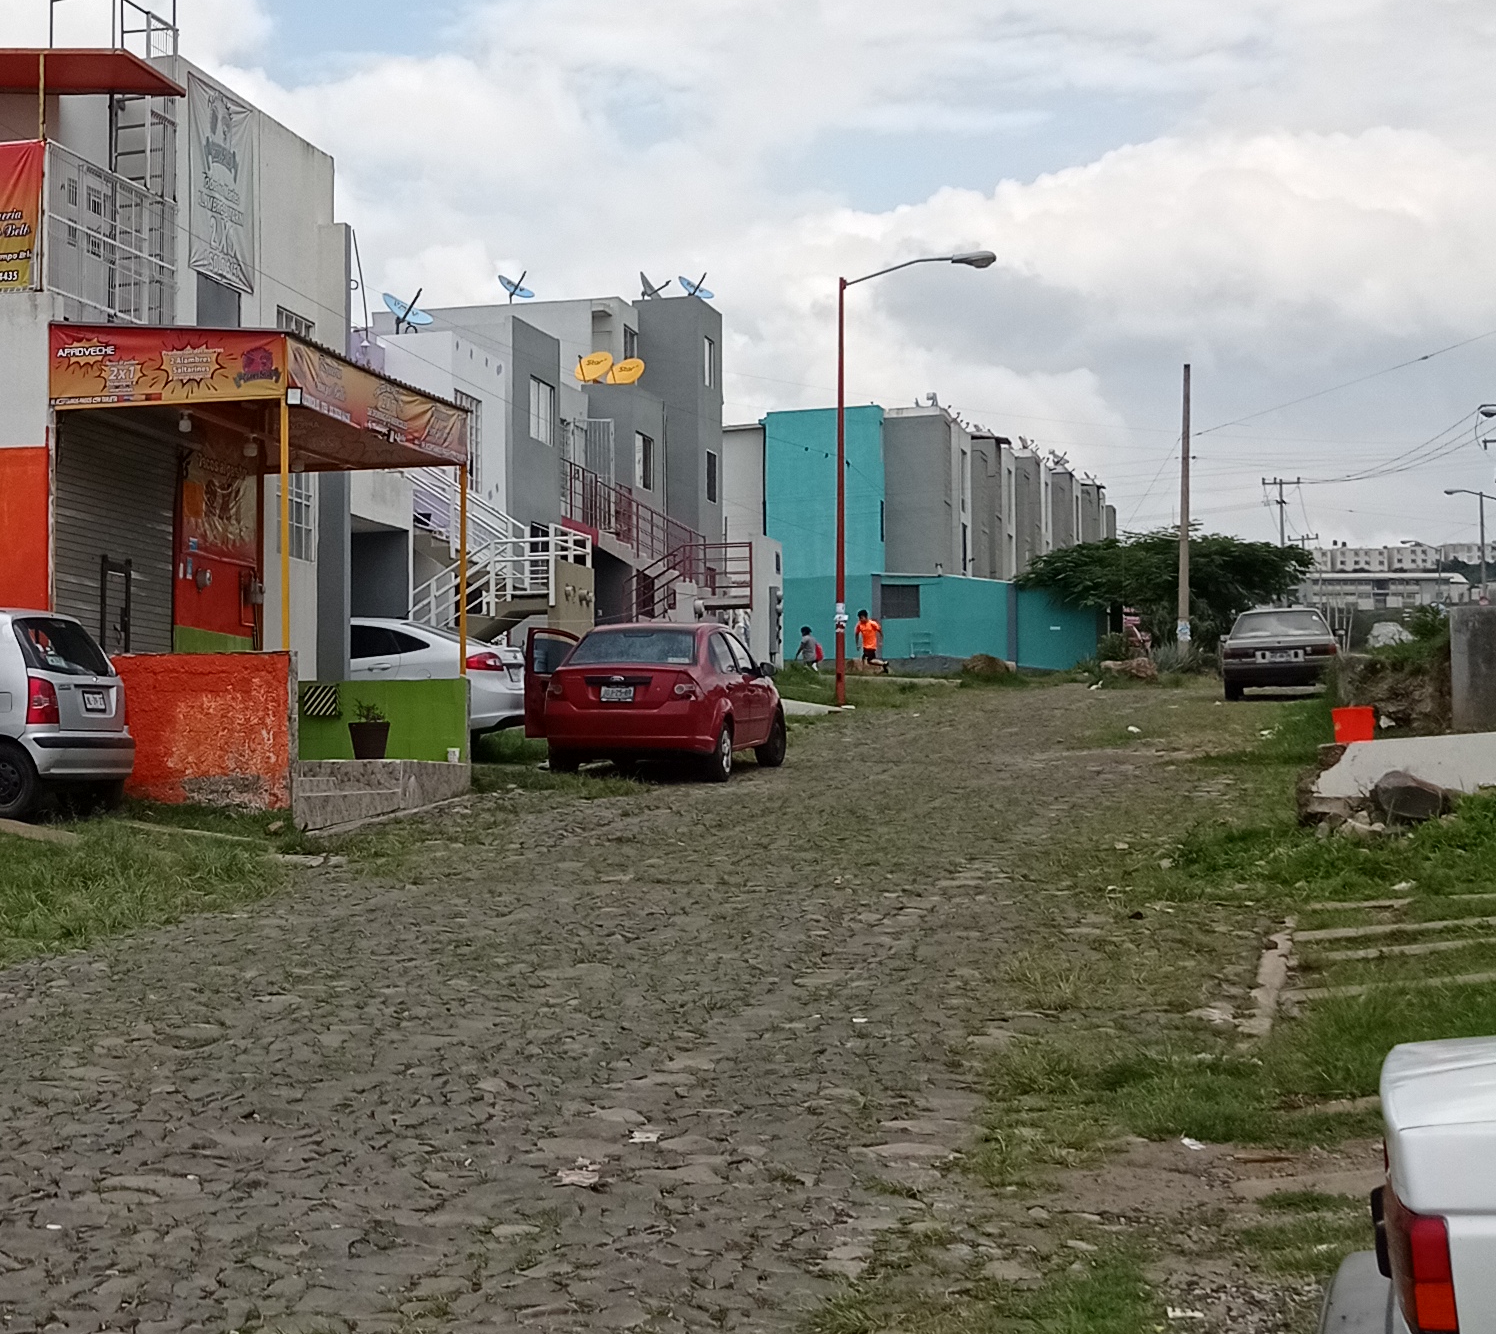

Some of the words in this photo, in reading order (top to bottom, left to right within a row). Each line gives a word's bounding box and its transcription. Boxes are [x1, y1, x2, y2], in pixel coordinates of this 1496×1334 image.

[57, 346, 115, 357] APROVECHE
[170, 357, 175, 365] 2
[176, 356, 211, 364] Alambres
[173, 365, 210, 374] Saltarines
